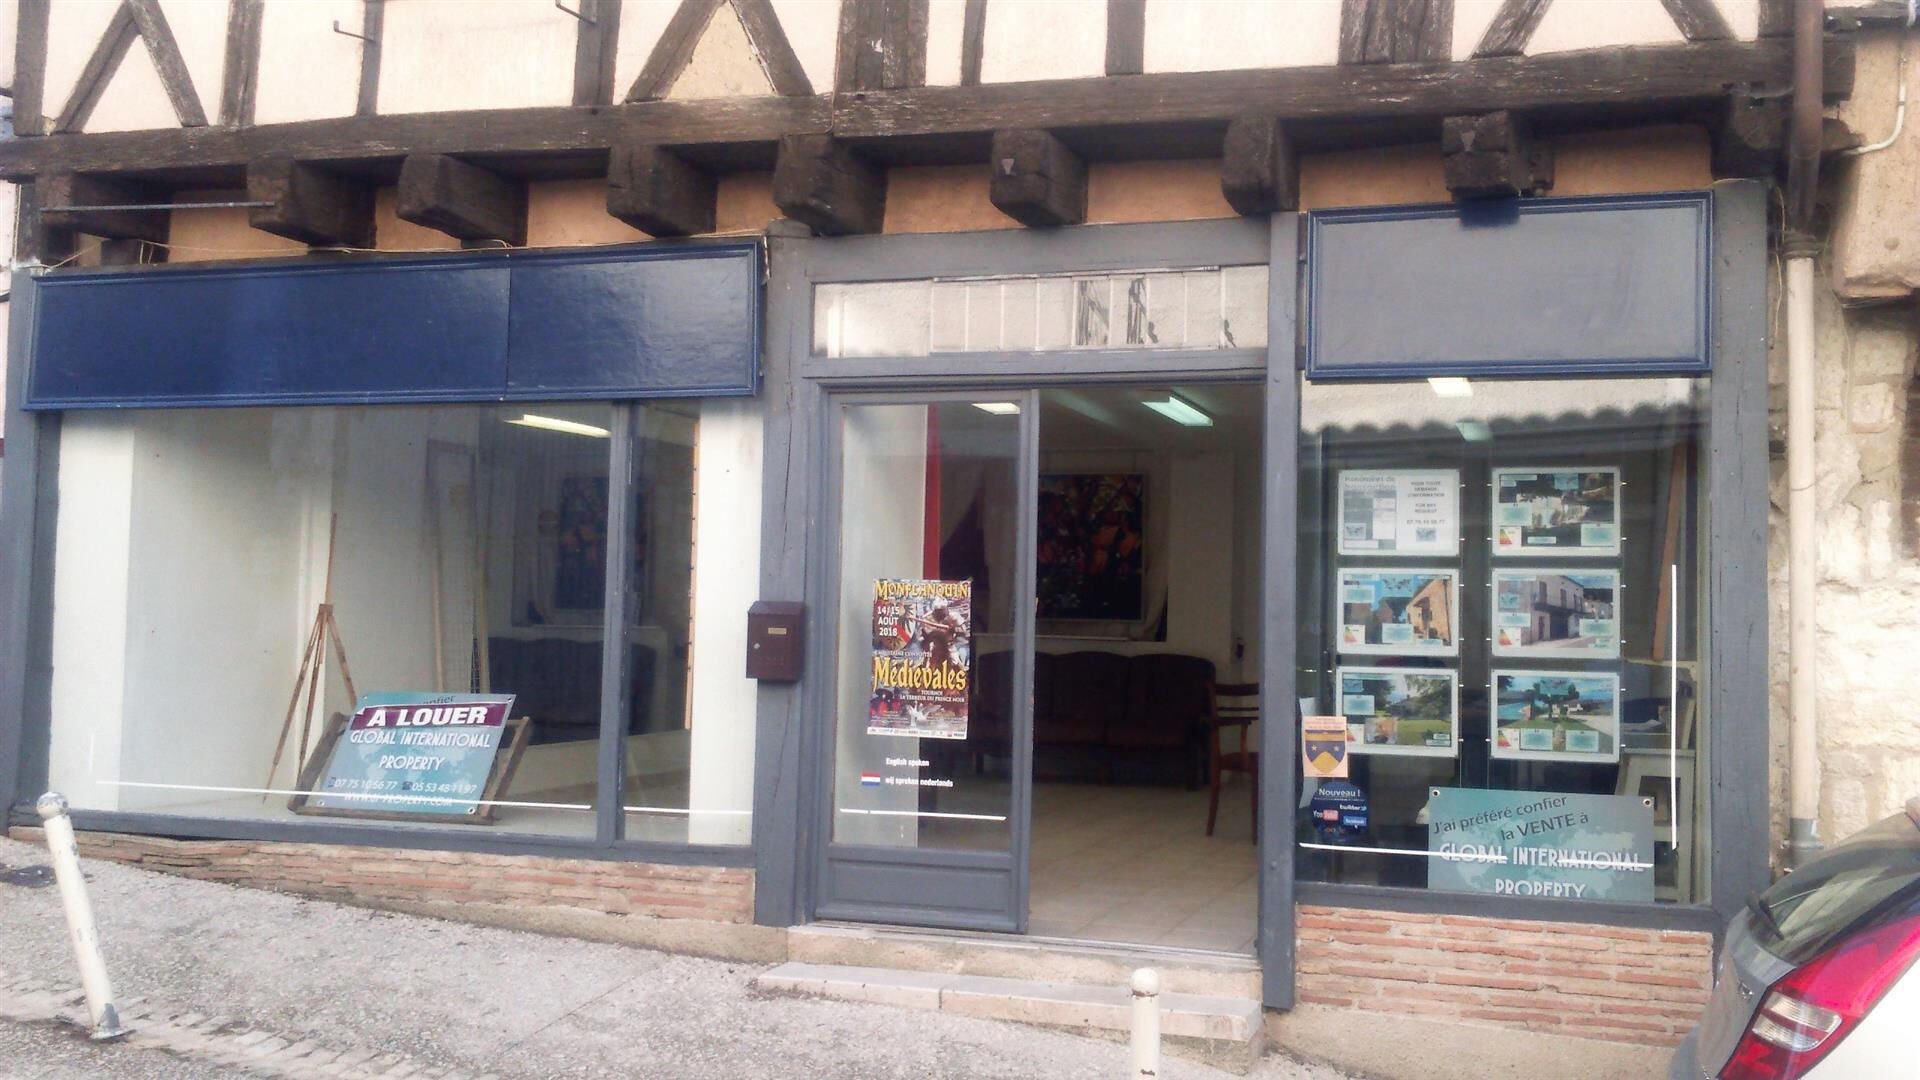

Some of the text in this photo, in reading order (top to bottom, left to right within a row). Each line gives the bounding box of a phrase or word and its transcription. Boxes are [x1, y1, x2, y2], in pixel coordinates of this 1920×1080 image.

[877, 606, 900, 616] 14/15
[366, 706, 488, 727] A LOUER
[350, 730, 491, 748] GLOBAL INTERNATIONAL
[378, 755, 445, 771] PROPERTY
[885, 757, 907, 767] English
[349, 778, 358, 789] 75
[384, 779, 398, 791] 77
[411, 782, 424, 792] 05
[425, 783, 437, 793] 53
[1318, 788, 1356, 797] Nouveau
[1432, 796, 1568, 834] J'ai préféré confier
[1500, 813, 1589, 841] la VENTE à
[1439, 842, 1645, 872] GLOBAL INTERNATIONAL
